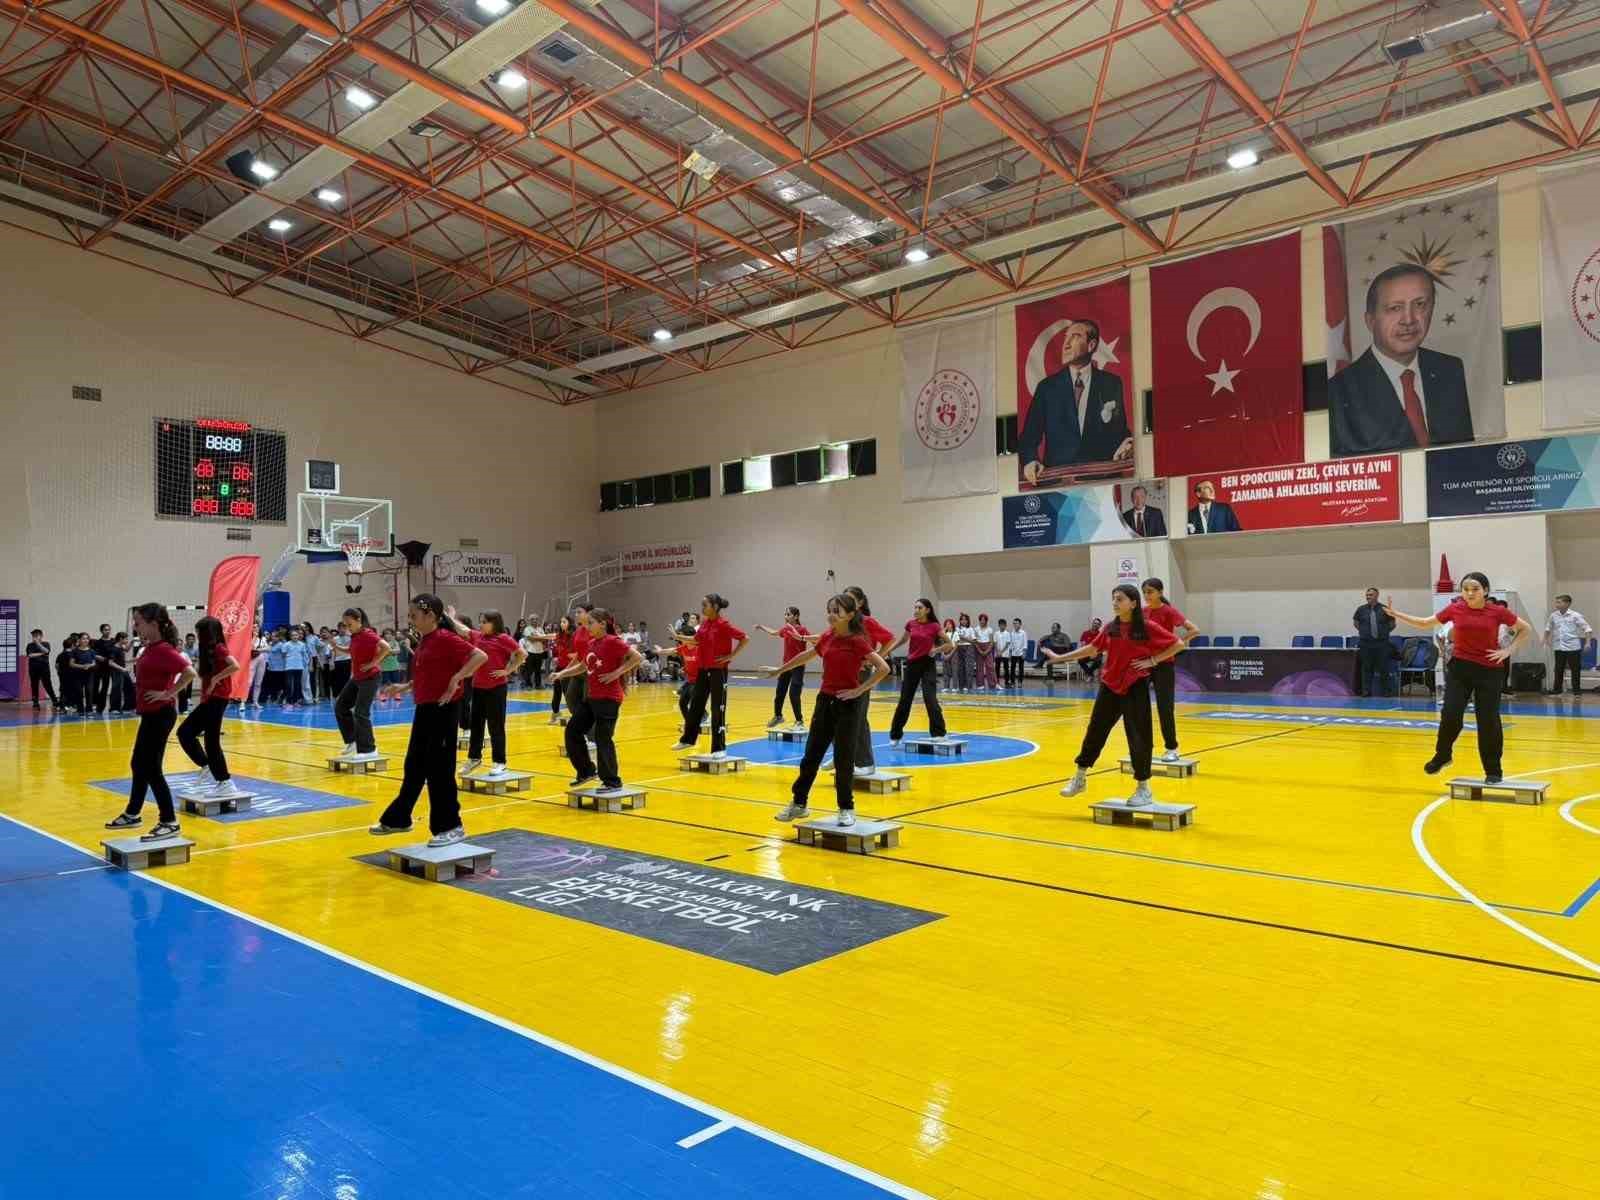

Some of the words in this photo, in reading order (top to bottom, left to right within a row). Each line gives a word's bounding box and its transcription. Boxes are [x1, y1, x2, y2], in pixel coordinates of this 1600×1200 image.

[1221, 475, 1238, 488] BEN
[1240, 468, 1294, 486] SPORCUNUN
[1296, 464, 1320, 481] ZEKİ,
[1322, 460, 1350, 480] ÇEVİK
[1352, 461, 1365, 474] VE
[1367, 460, 1392, 473] AYNI
[1442, 480, 1460, 491] TÜM
[1461, 477, 1503, 489] ANTRENÖR
[1504, 476, 1514, 485] VE
[1231, 486, 1274, 503] ZAMANDA
[1276, 482, 1333, 498] AHLAKLISINI
[1335, 475, 1381, 493] SEVERİM.
[463, 566, 505, 575] VOLEYBOL
[652, 868, 840, 912] HALKBANK
[547, 877, 762, 934] BASKETBOL
[670, 889, 799, 922] KADINLAR
